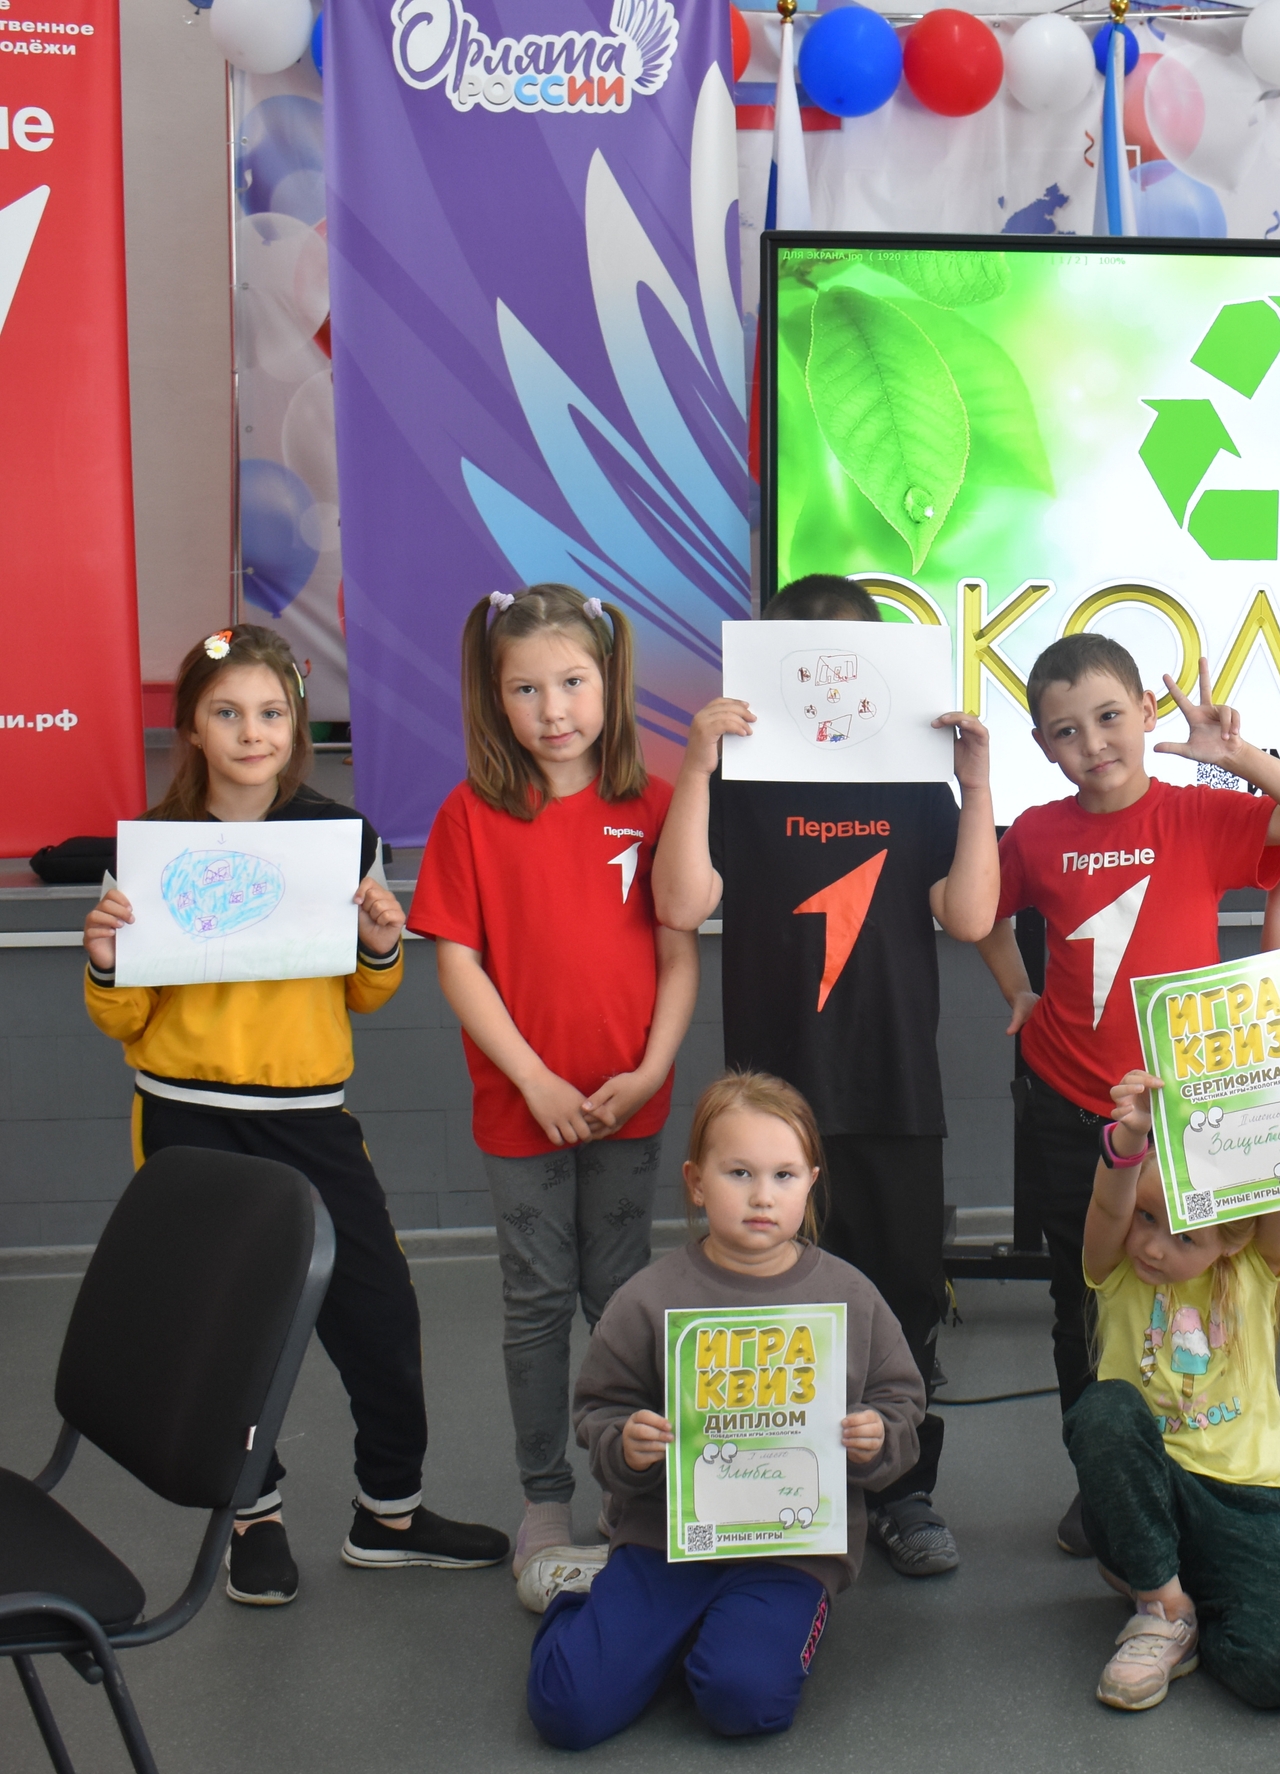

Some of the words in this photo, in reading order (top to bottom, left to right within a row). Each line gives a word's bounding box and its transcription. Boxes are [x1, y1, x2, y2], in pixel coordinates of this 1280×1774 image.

[458, 75, 624, 105] РОССИИ
[783, 251, 803, 260] ДЛЯ
[806, 251, 863, 262] ЭКРАНА.jpg
[877, 253, 900, 261] 1920
[604, 826, 645, 839] Первые
[787, 817, 890, 843] Первые
[1062, 848, 1155, 875] Первые
[1192, 1092, 1228, 1103] УЧАСТНИКА
[1216, 1193, 1251, 1207] УМНЫЕ
[1253, 1187, 1280, 1201] ИГРЫ
[697, 1326, 816, 1368] ИГРА
[697, 1367, 816, 1409] КВИЗ
[705, 1411, 806, 1433] ДИПЛОМ
[717, 1463, 786, 1479] Улыбка
[717, 1533, 753, 1542] УМНЫЕ
[755, 1532, 783, 1540] ИГРЫ
